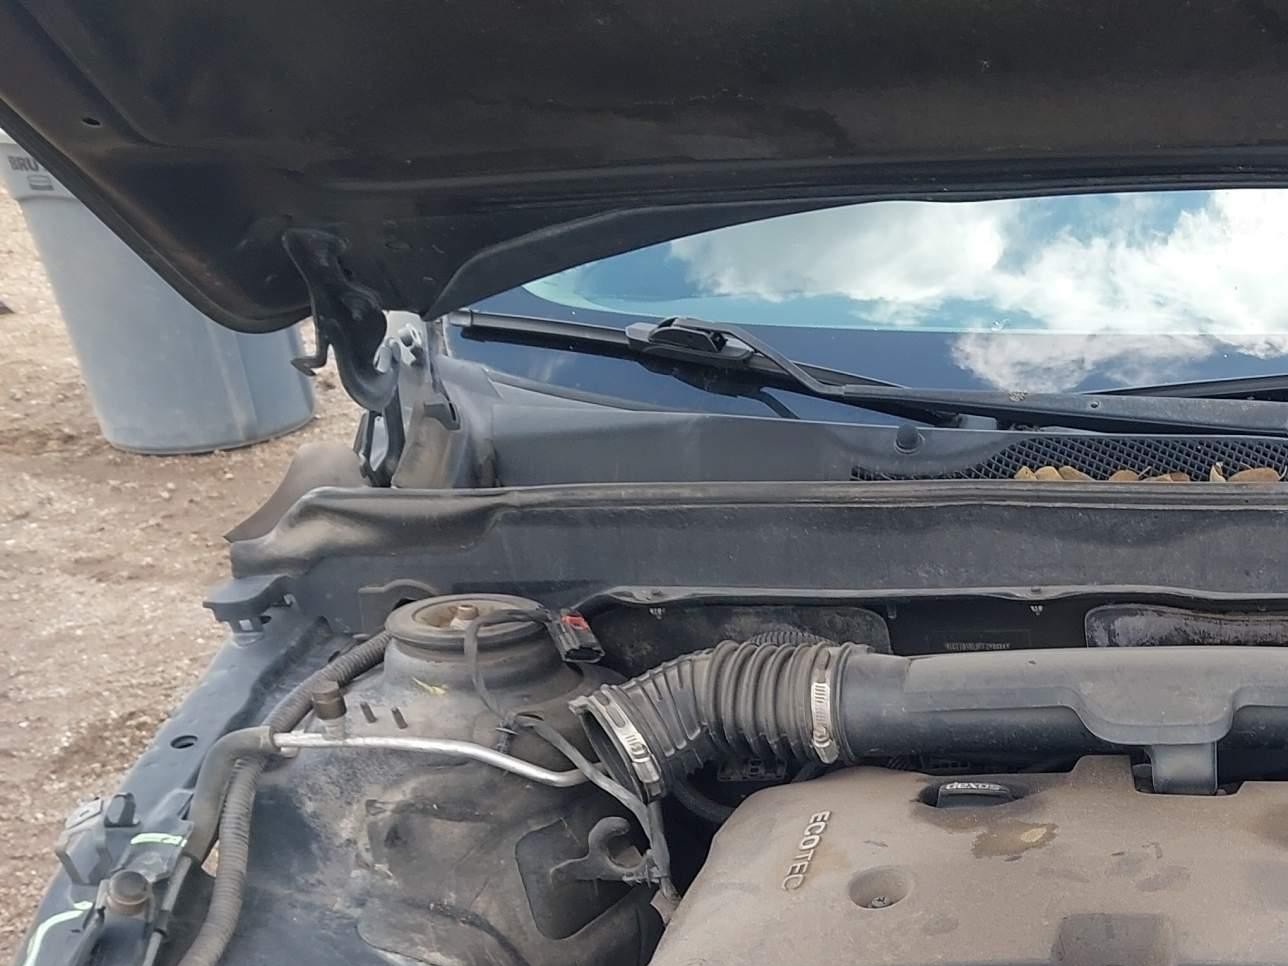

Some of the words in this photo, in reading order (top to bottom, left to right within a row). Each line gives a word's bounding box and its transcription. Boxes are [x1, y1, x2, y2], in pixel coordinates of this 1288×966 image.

[8, 155, 48, 172] BRU
[945, 781, 1001, 791] dexos
[782, 811, 831, 890] ECOTEC
